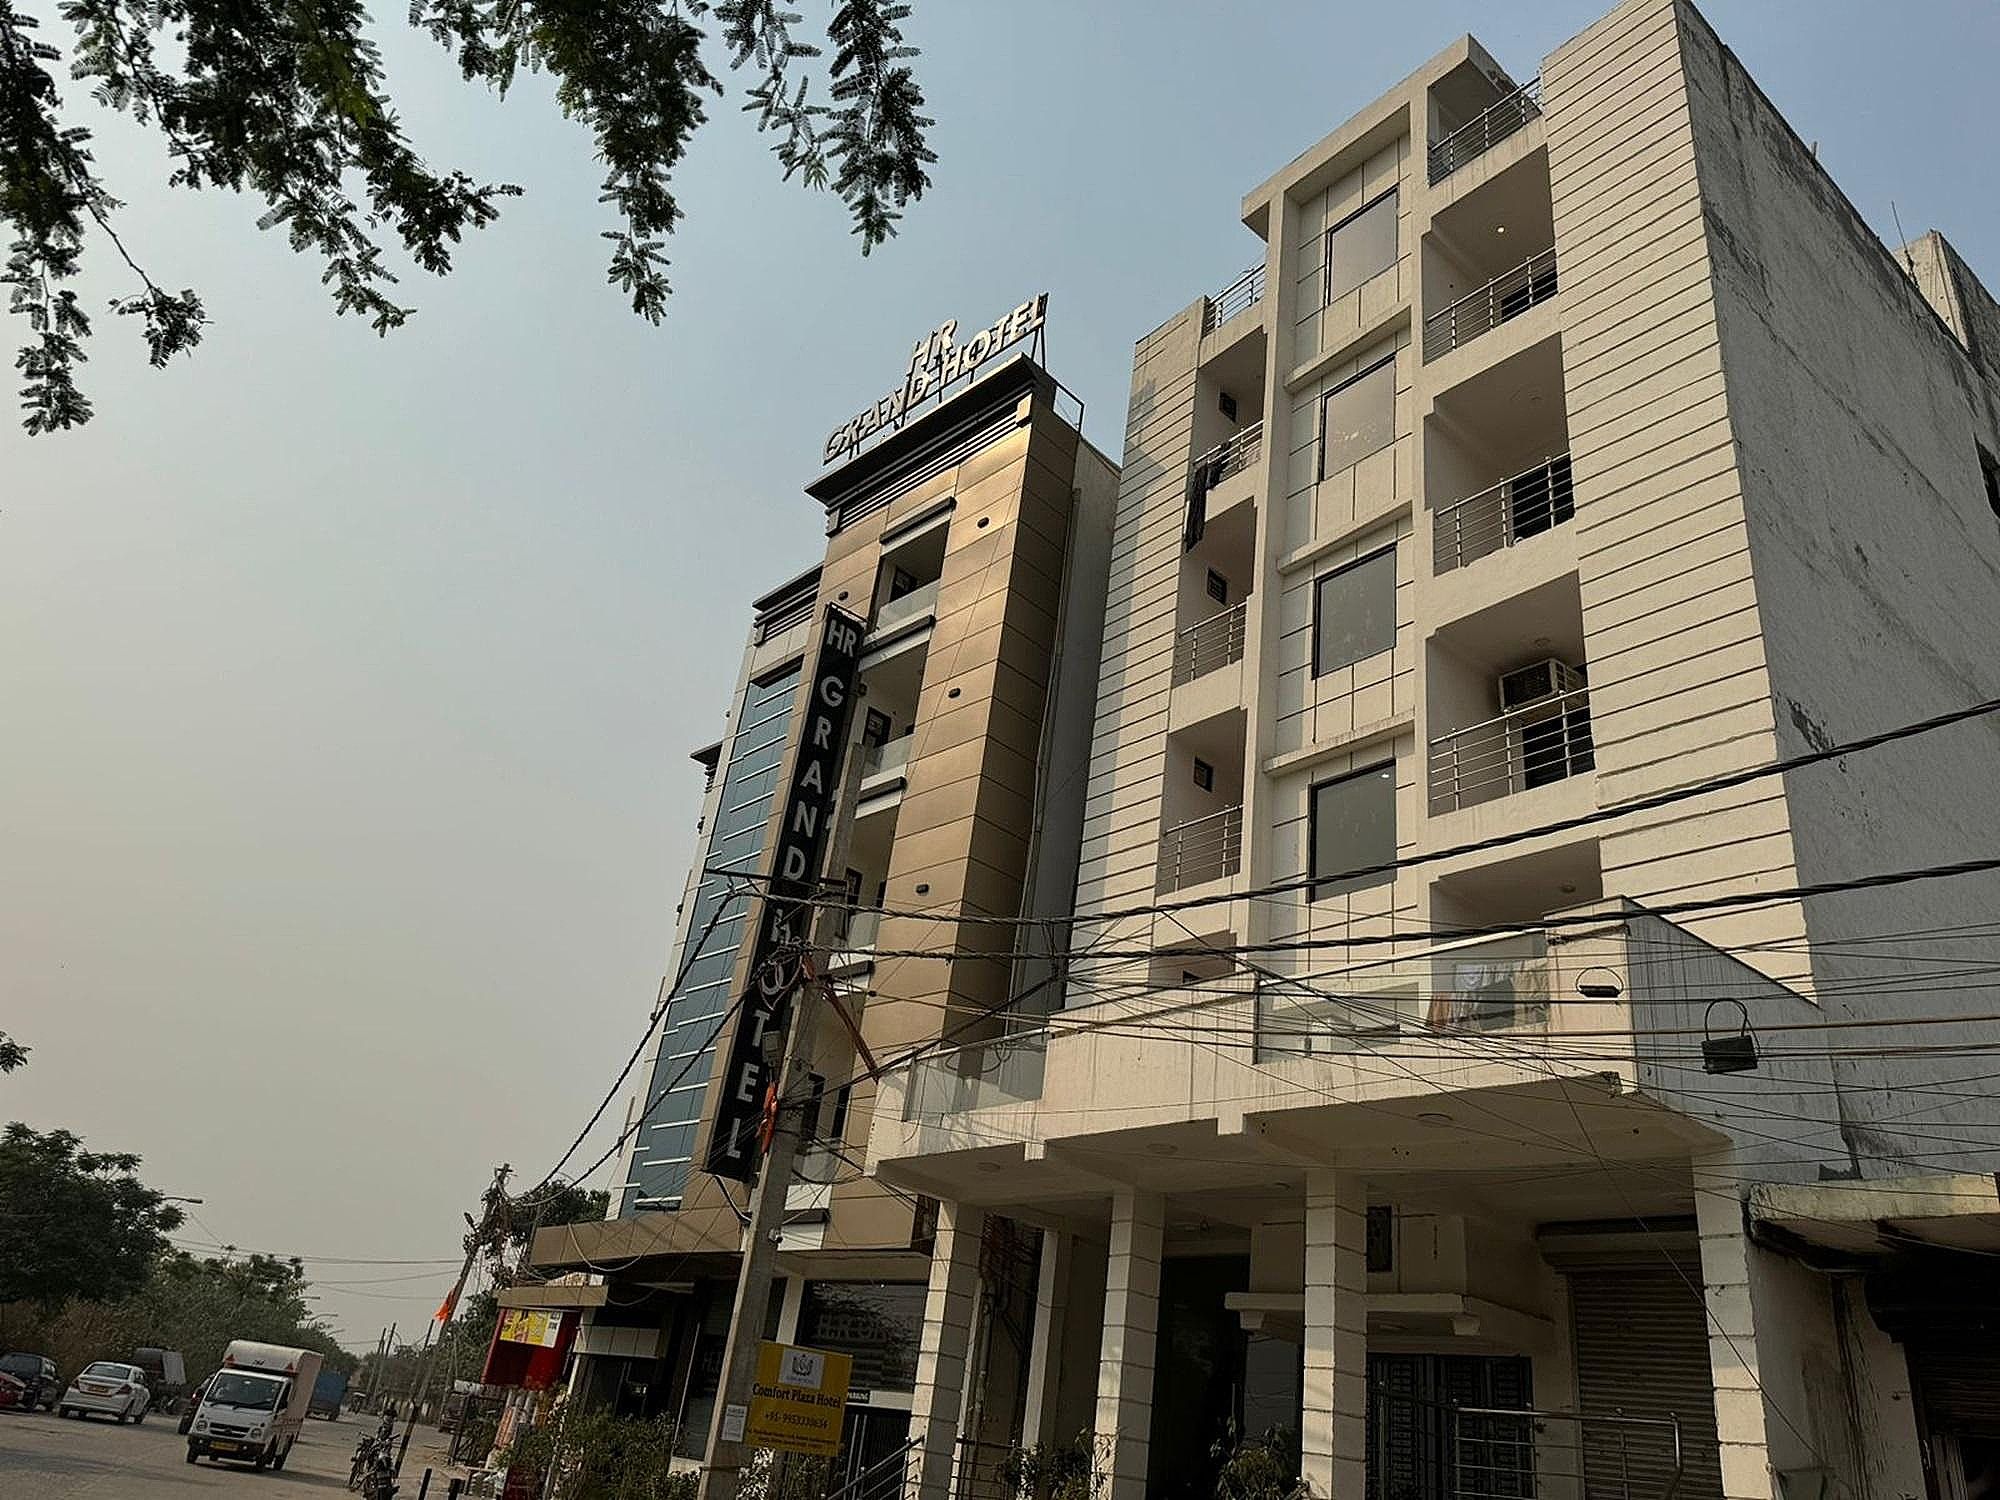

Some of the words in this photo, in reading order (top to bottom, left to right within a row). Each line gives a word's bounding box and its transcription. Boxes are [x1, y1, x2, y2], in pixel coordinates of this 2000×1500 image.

[908, 319, 957, 373] HR
[823, 371, 930, 462] GRAND
[941, 293, 1048, 387] HOTEL
[826, 619, 858, 657] HR
[783, 676, 844, 881] GRAND
[752, 1382, 790, 1401] Comfort
[791, 1388, 815, 1404] Plaza
[816, 1391, 841, 1408] Hotel
